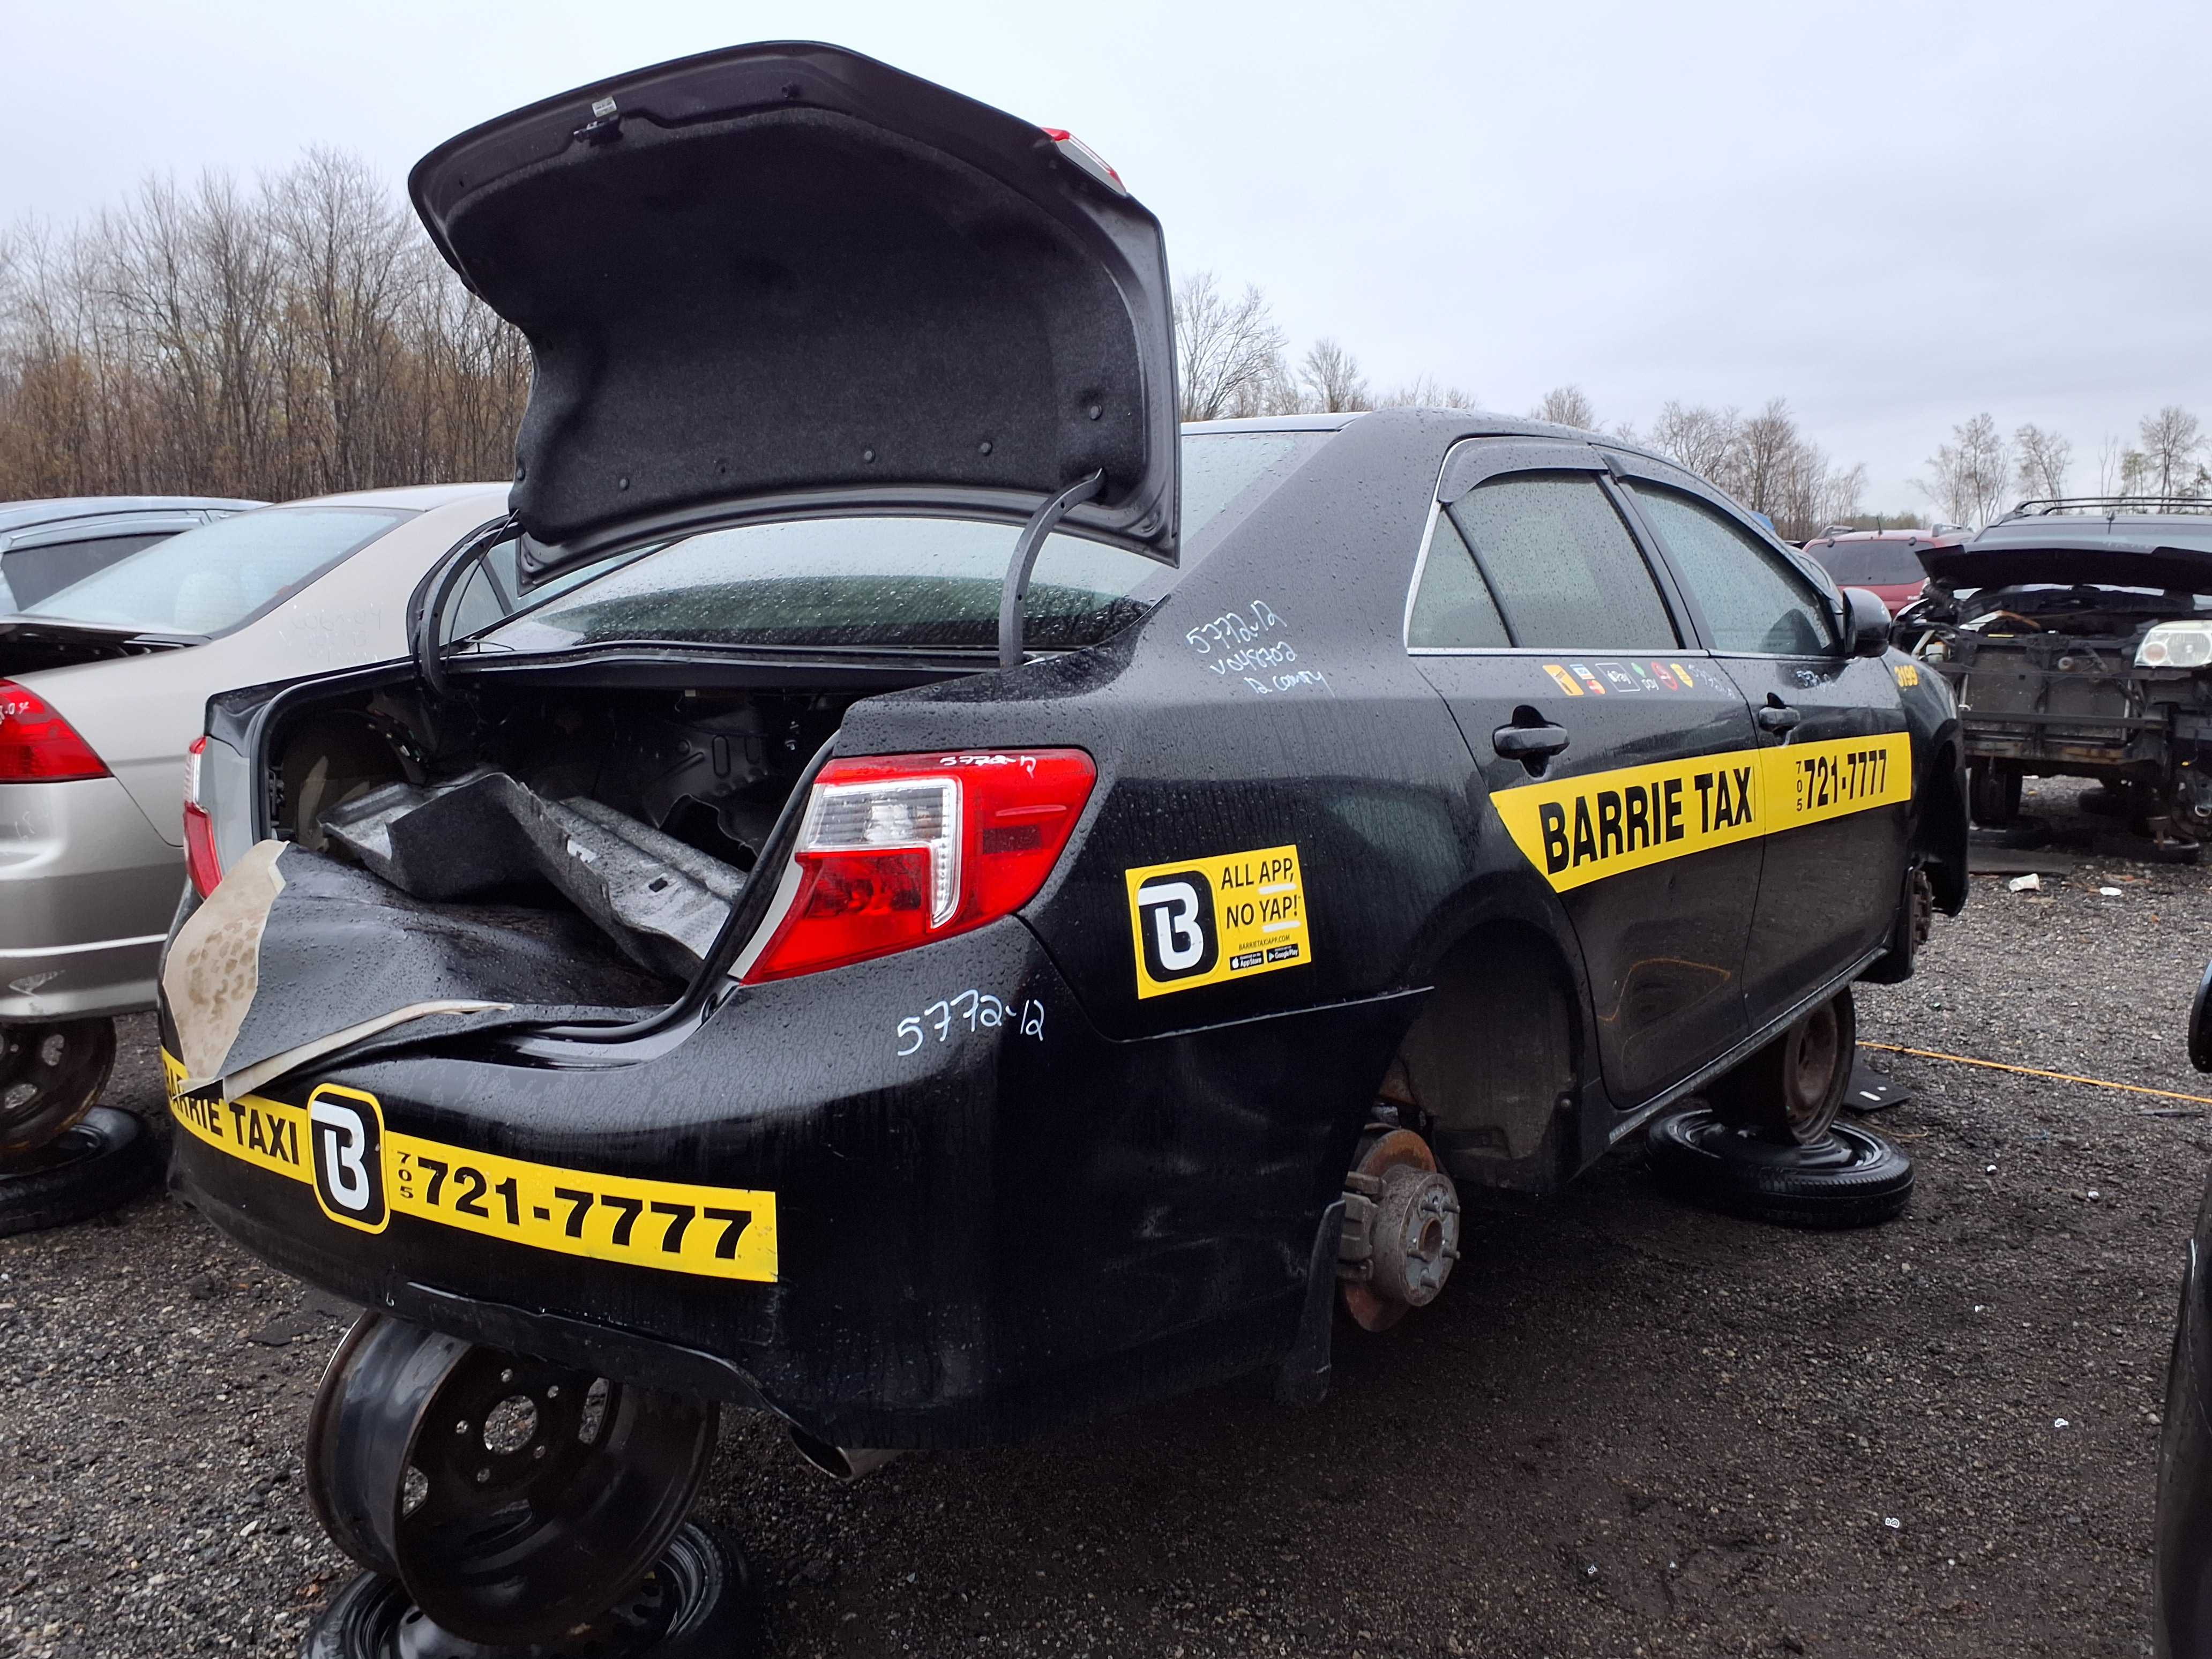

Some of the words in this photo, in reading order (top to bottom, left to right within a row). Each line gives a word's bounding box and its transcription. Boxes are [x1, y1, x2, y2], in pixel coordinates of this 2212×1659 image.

[1804, 749, 1888, 810] 721-7777
[1538, 778, 1685, 876] BARRIE
[1694, 766, 1754, 834] TAX
[1221, 864, 1254, 890] ALL
[1225, 902, 1255, 929] NO
[1259, 894, 1298, 922] YAP!
[1238, 934, 1290, 950] BARRIETAXIAPP.COM
[229, 1101, 300, 1166] TAXI
[417, 1156, 752, 1261] 721-7777
